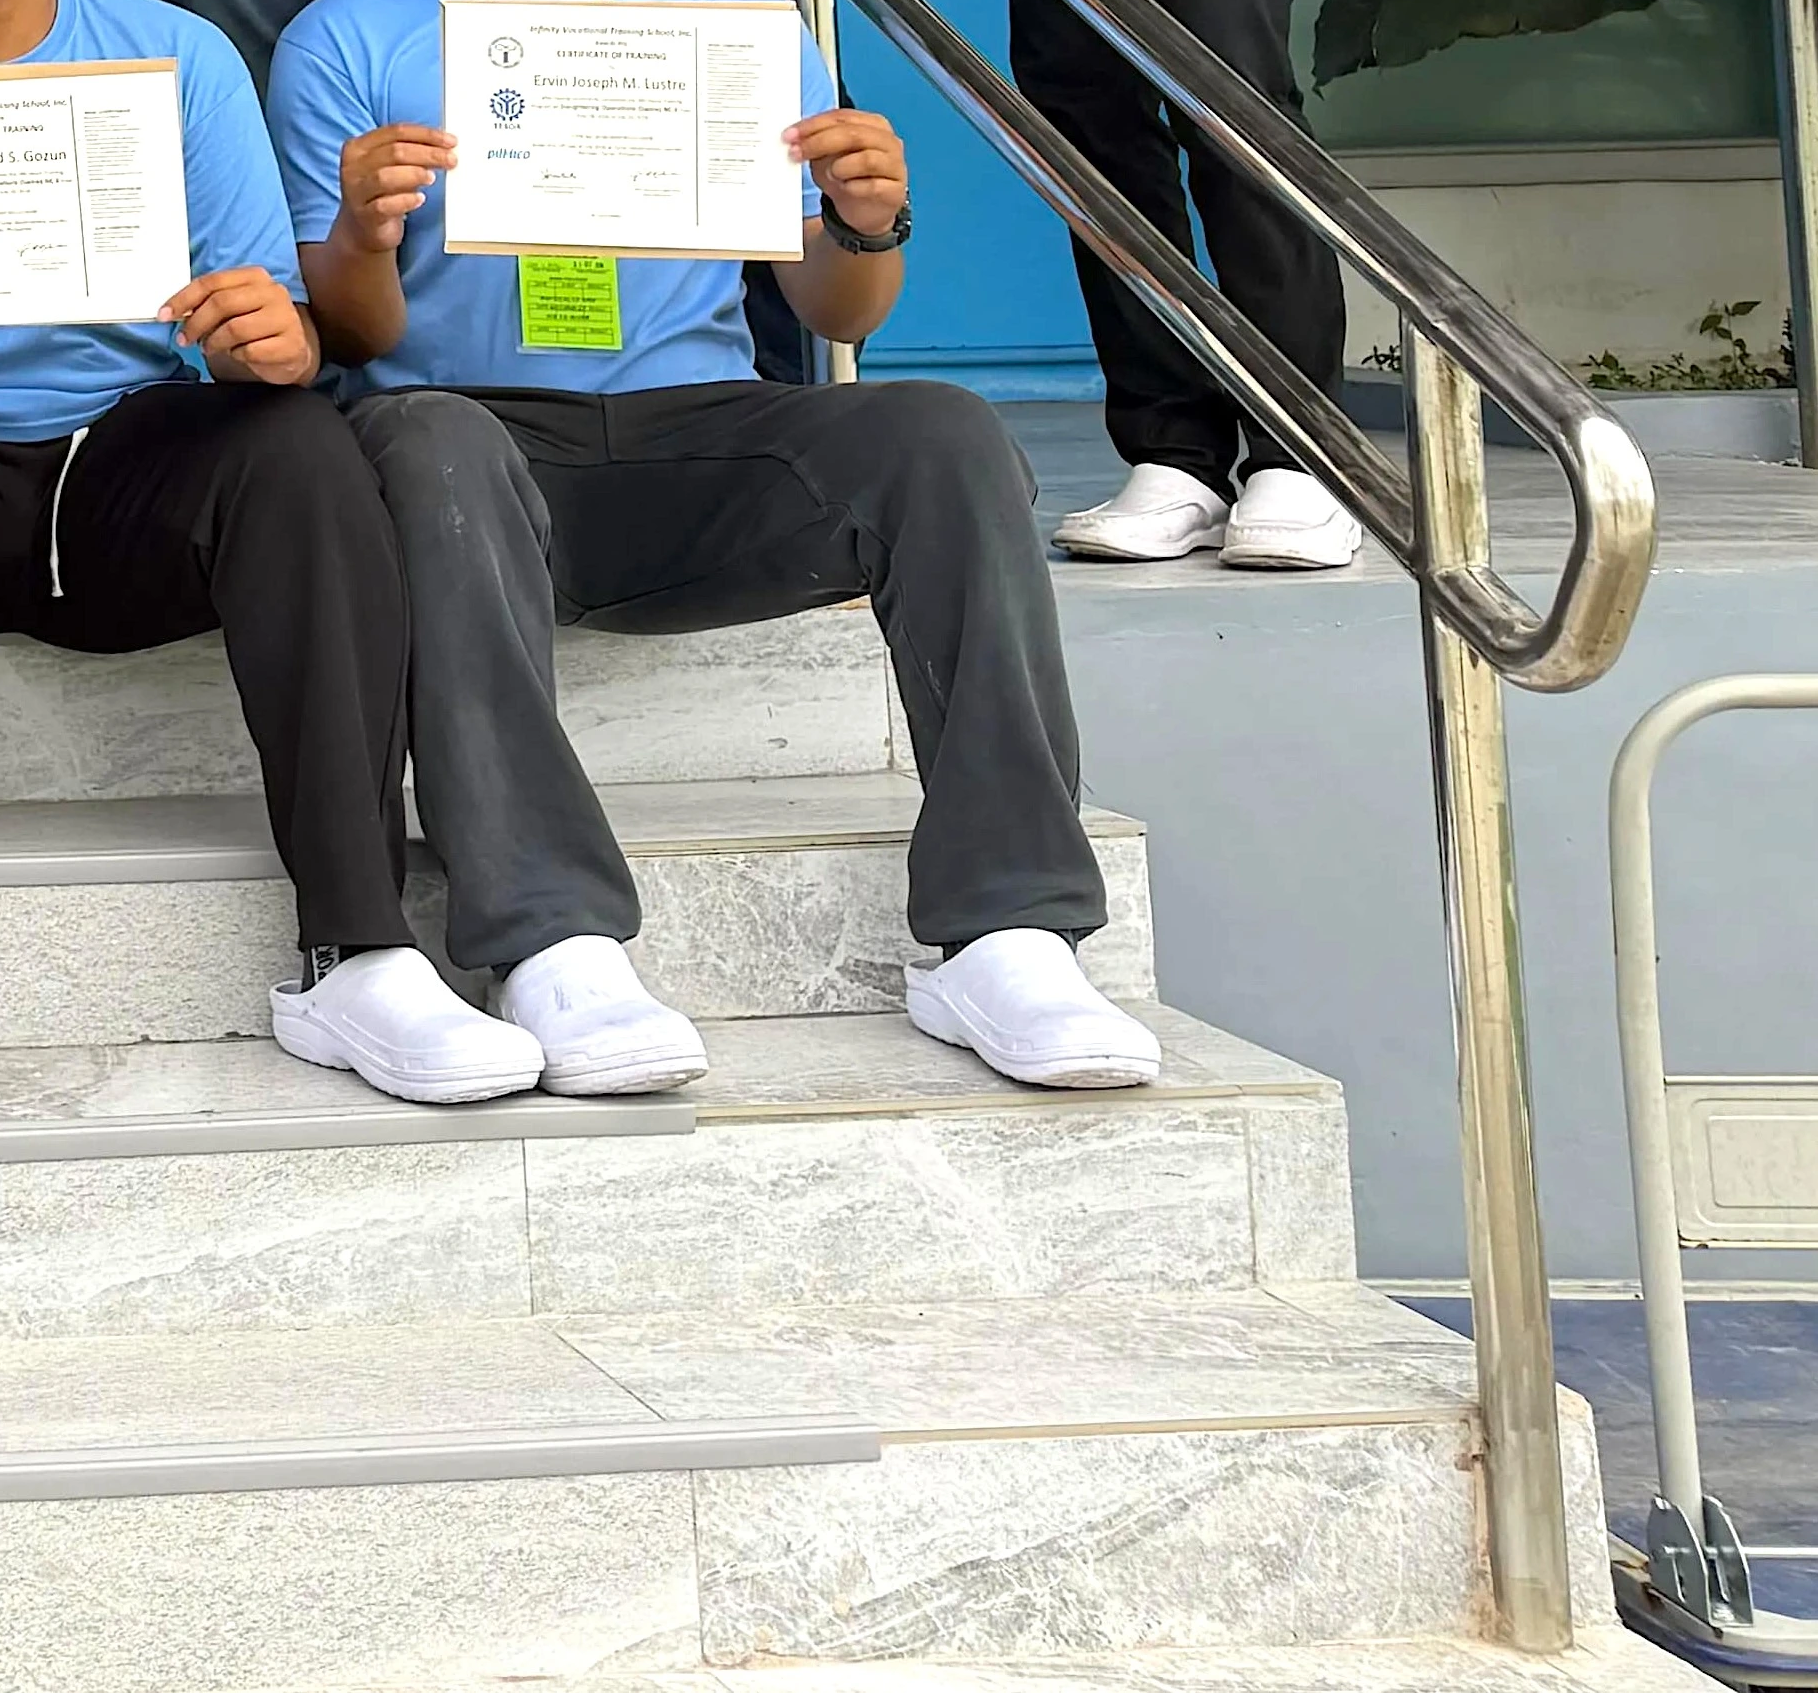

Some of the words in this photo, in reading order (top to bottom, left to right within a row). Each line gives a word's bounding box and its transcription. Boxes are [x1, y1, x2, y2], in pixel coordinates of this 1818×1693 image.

[534, 74, 567, 87] Ervin
[572, 75, 618, 89] Joseph
[644, 78, 686, 90] Lustre
[23, 149, 67, 162] Gozun
